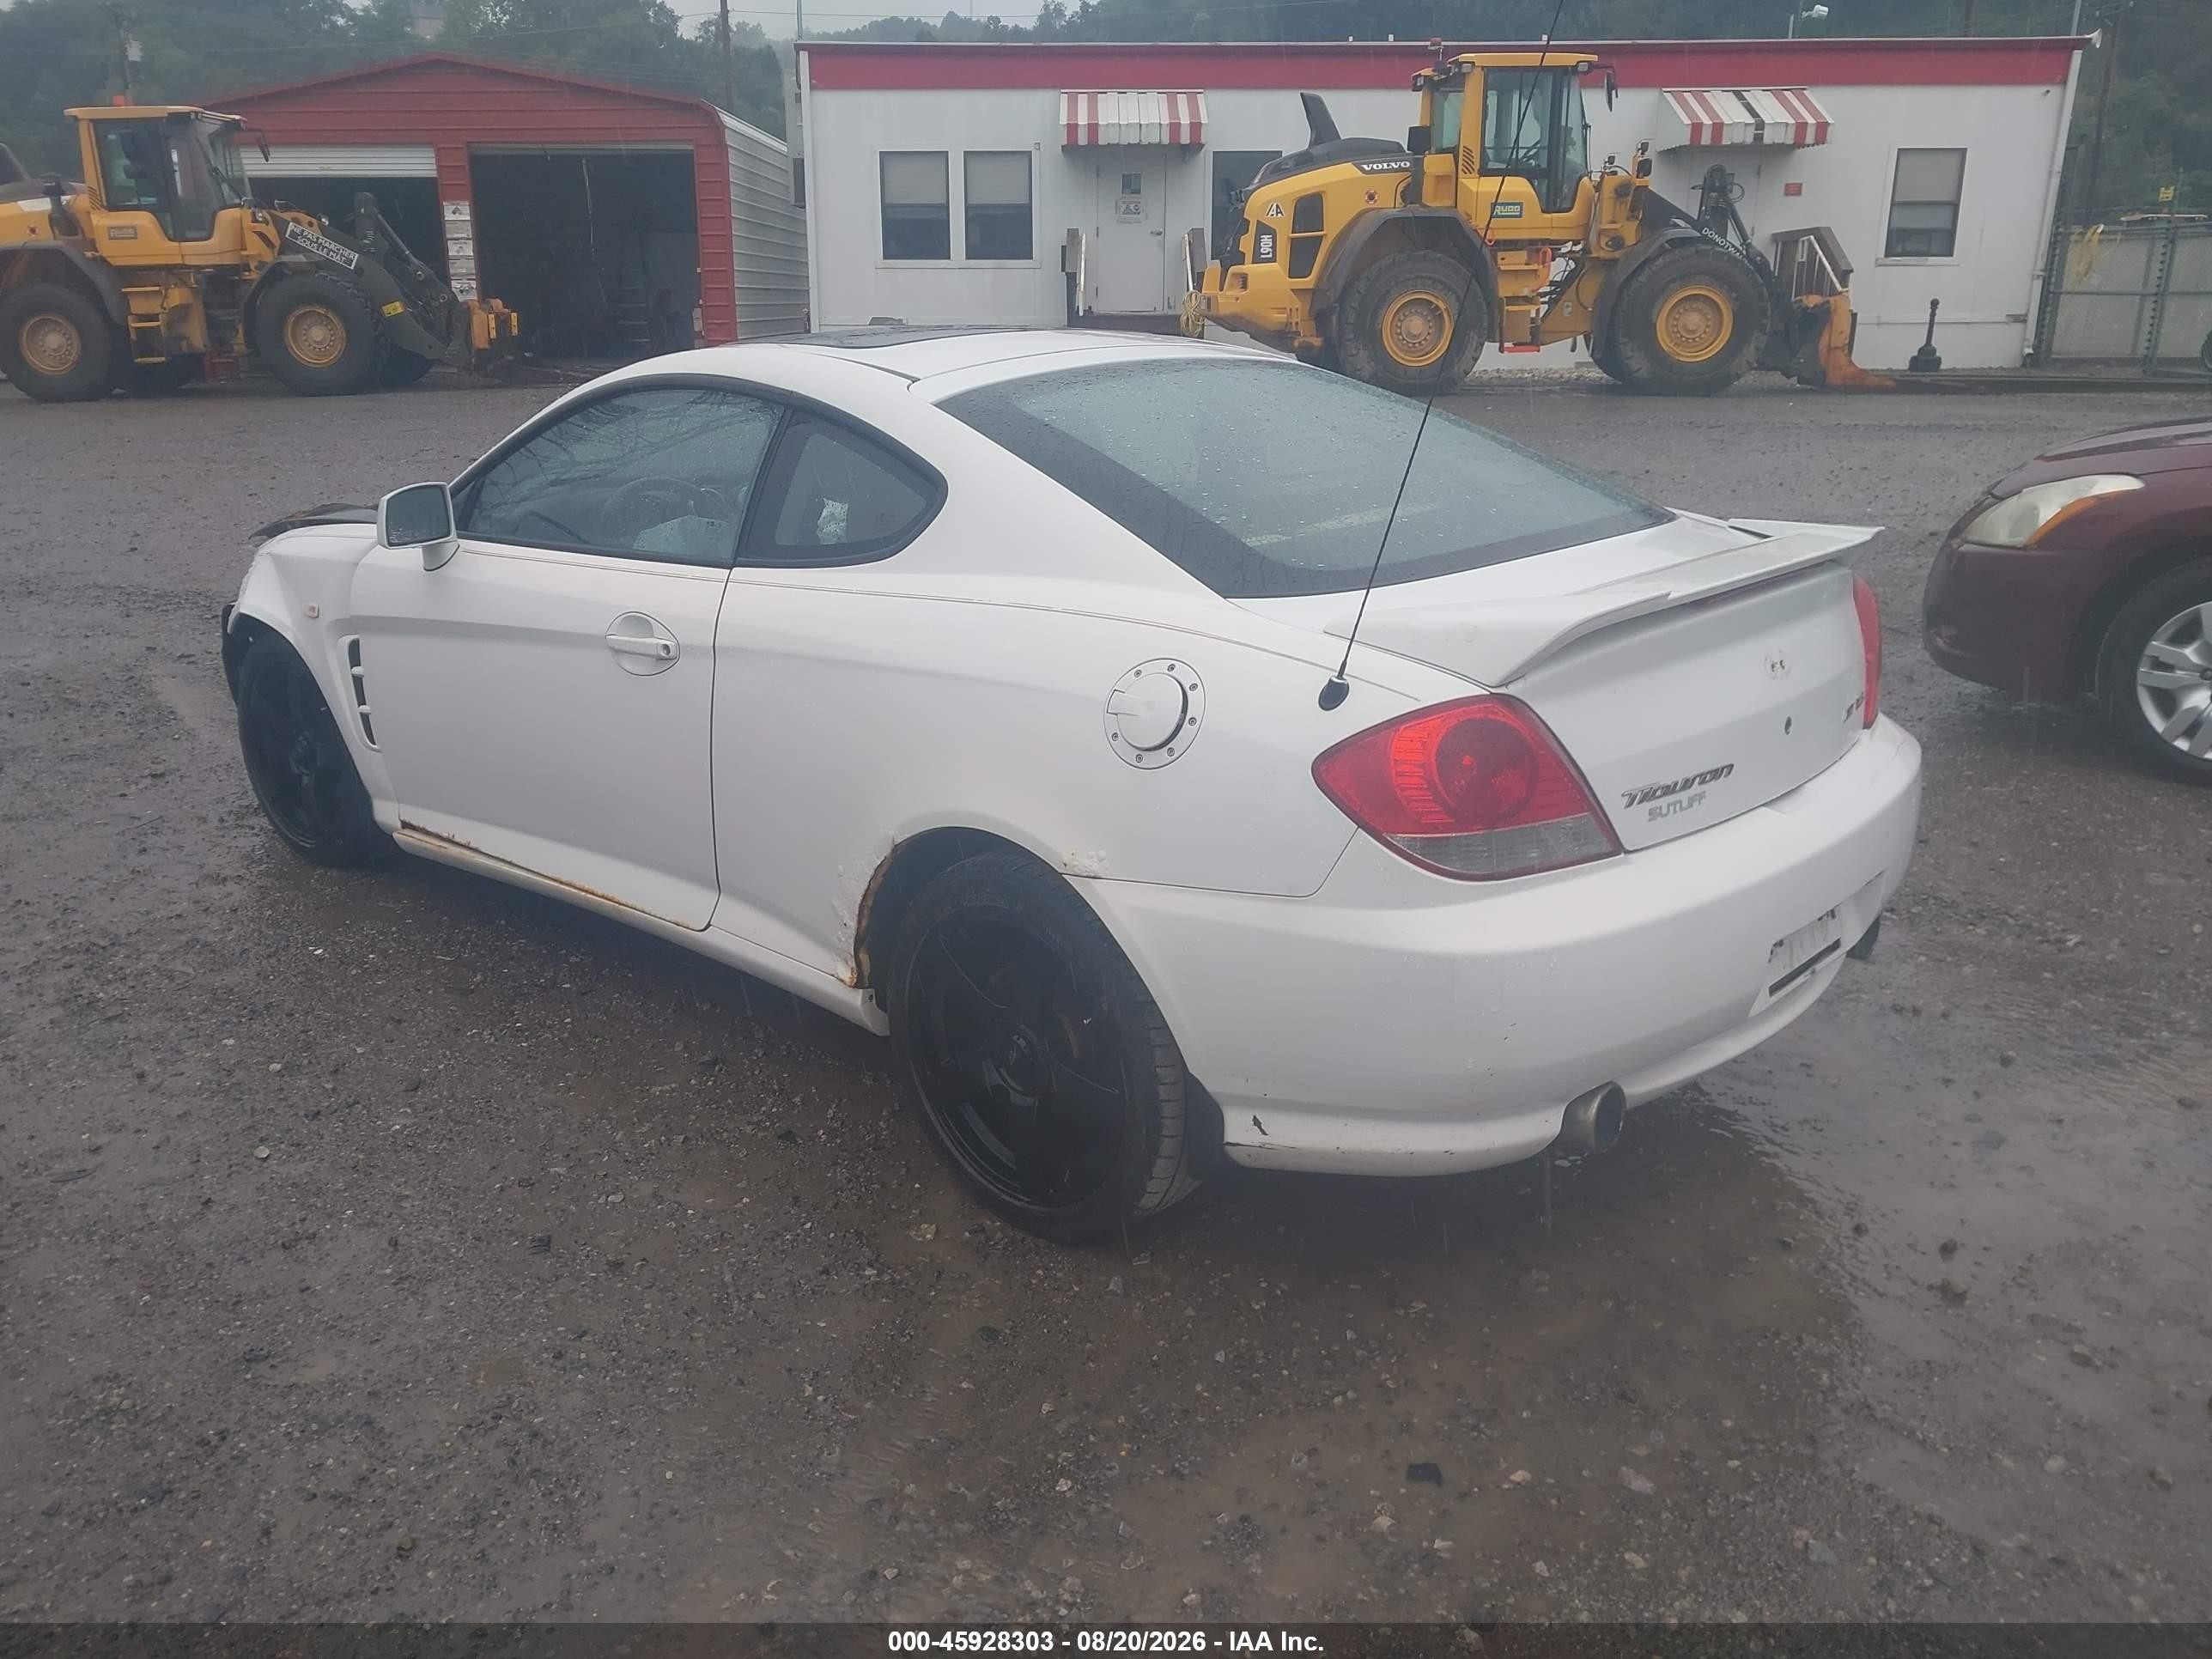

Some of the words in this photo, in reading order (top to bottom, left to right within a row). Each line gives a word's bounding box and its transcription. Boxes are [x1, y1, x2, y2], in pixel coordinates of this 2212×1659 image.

[1361, 161, 1411, 171] VOLVO
[291, 225, 302, 235] NE
[303, 231, 317, 240] PAS
[318, 239, 355, 260] MARCHER
[297, 236, 319, 250] SOUS
[319, 246, 328, 255] LE
[1260, 234, 1273, 258] L90H
[1648, 790, 1706, 822] SUTLIFF
